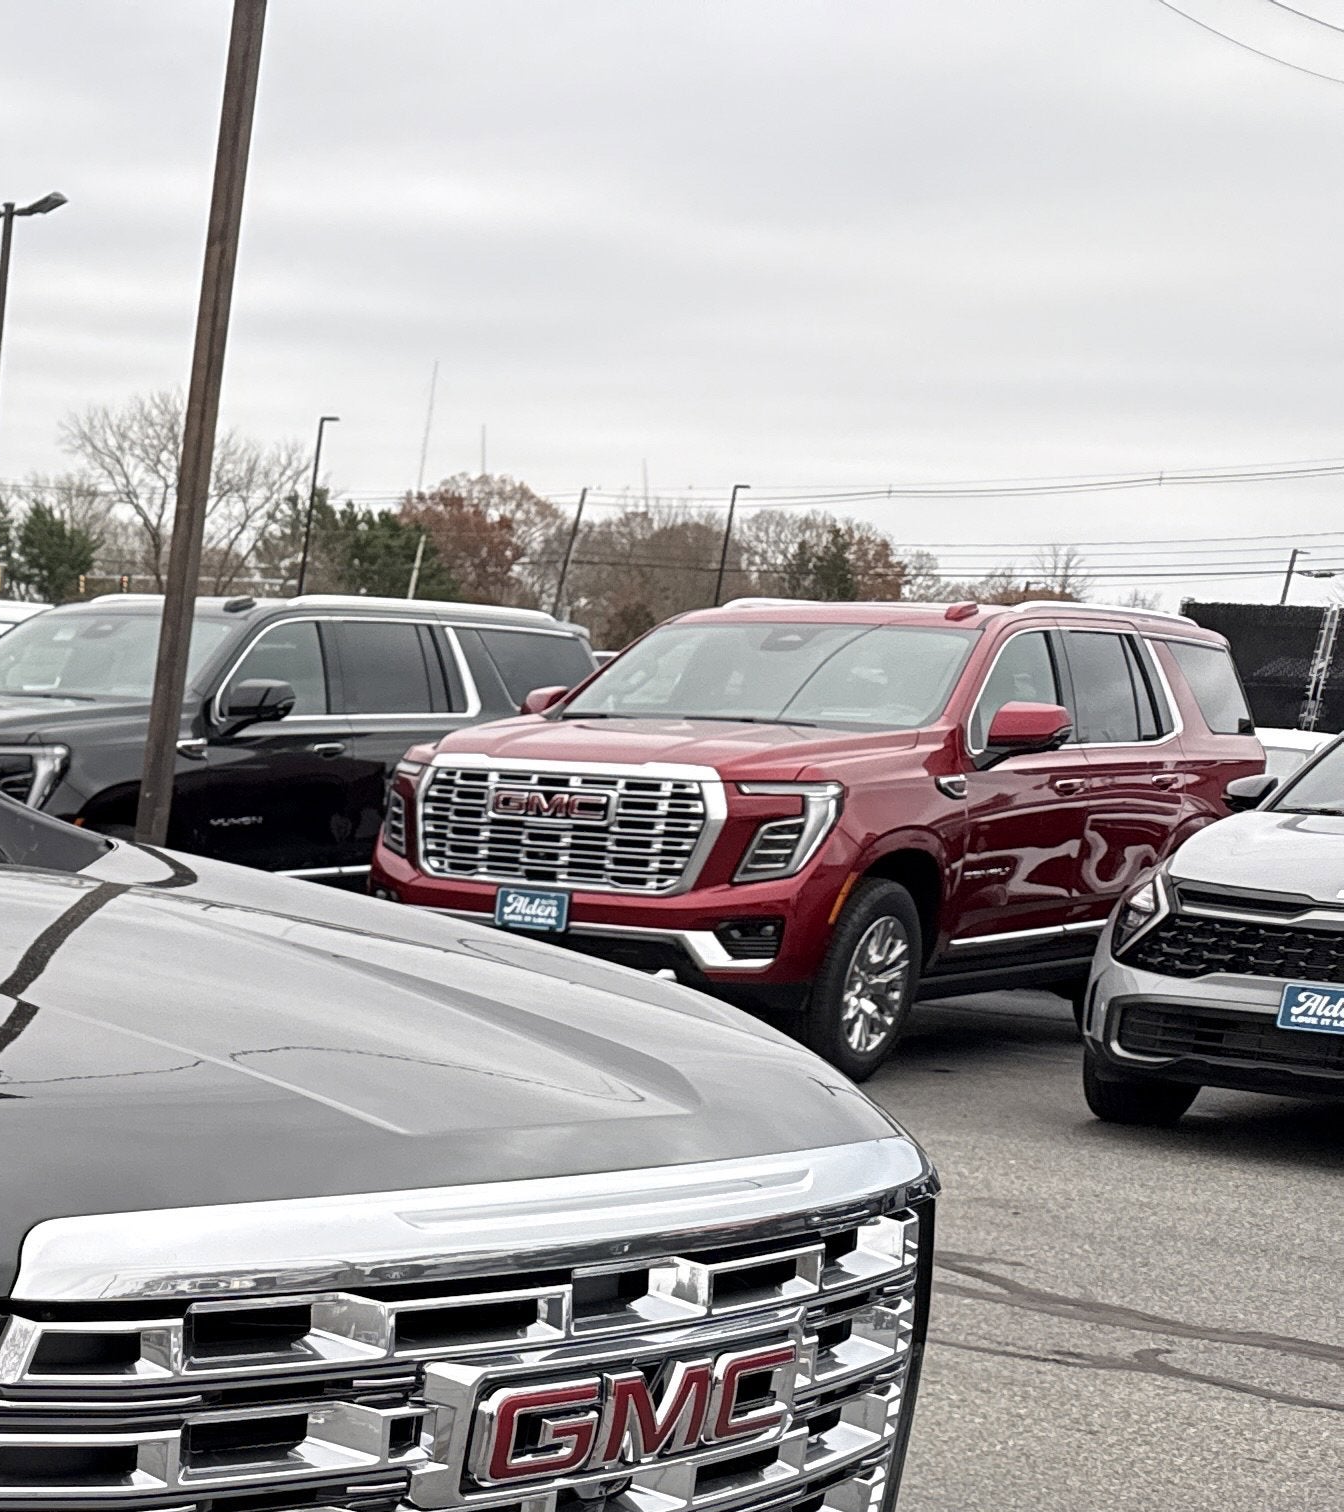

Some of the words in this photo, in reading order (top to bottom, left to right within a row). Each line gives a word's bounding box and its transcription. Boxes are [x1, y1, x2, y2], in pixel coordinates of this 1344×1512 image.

[494, 790, 608, 820] GMC
[502, 893, 560, 918] Alden
[472, 1340, 797, 1487] GMC
